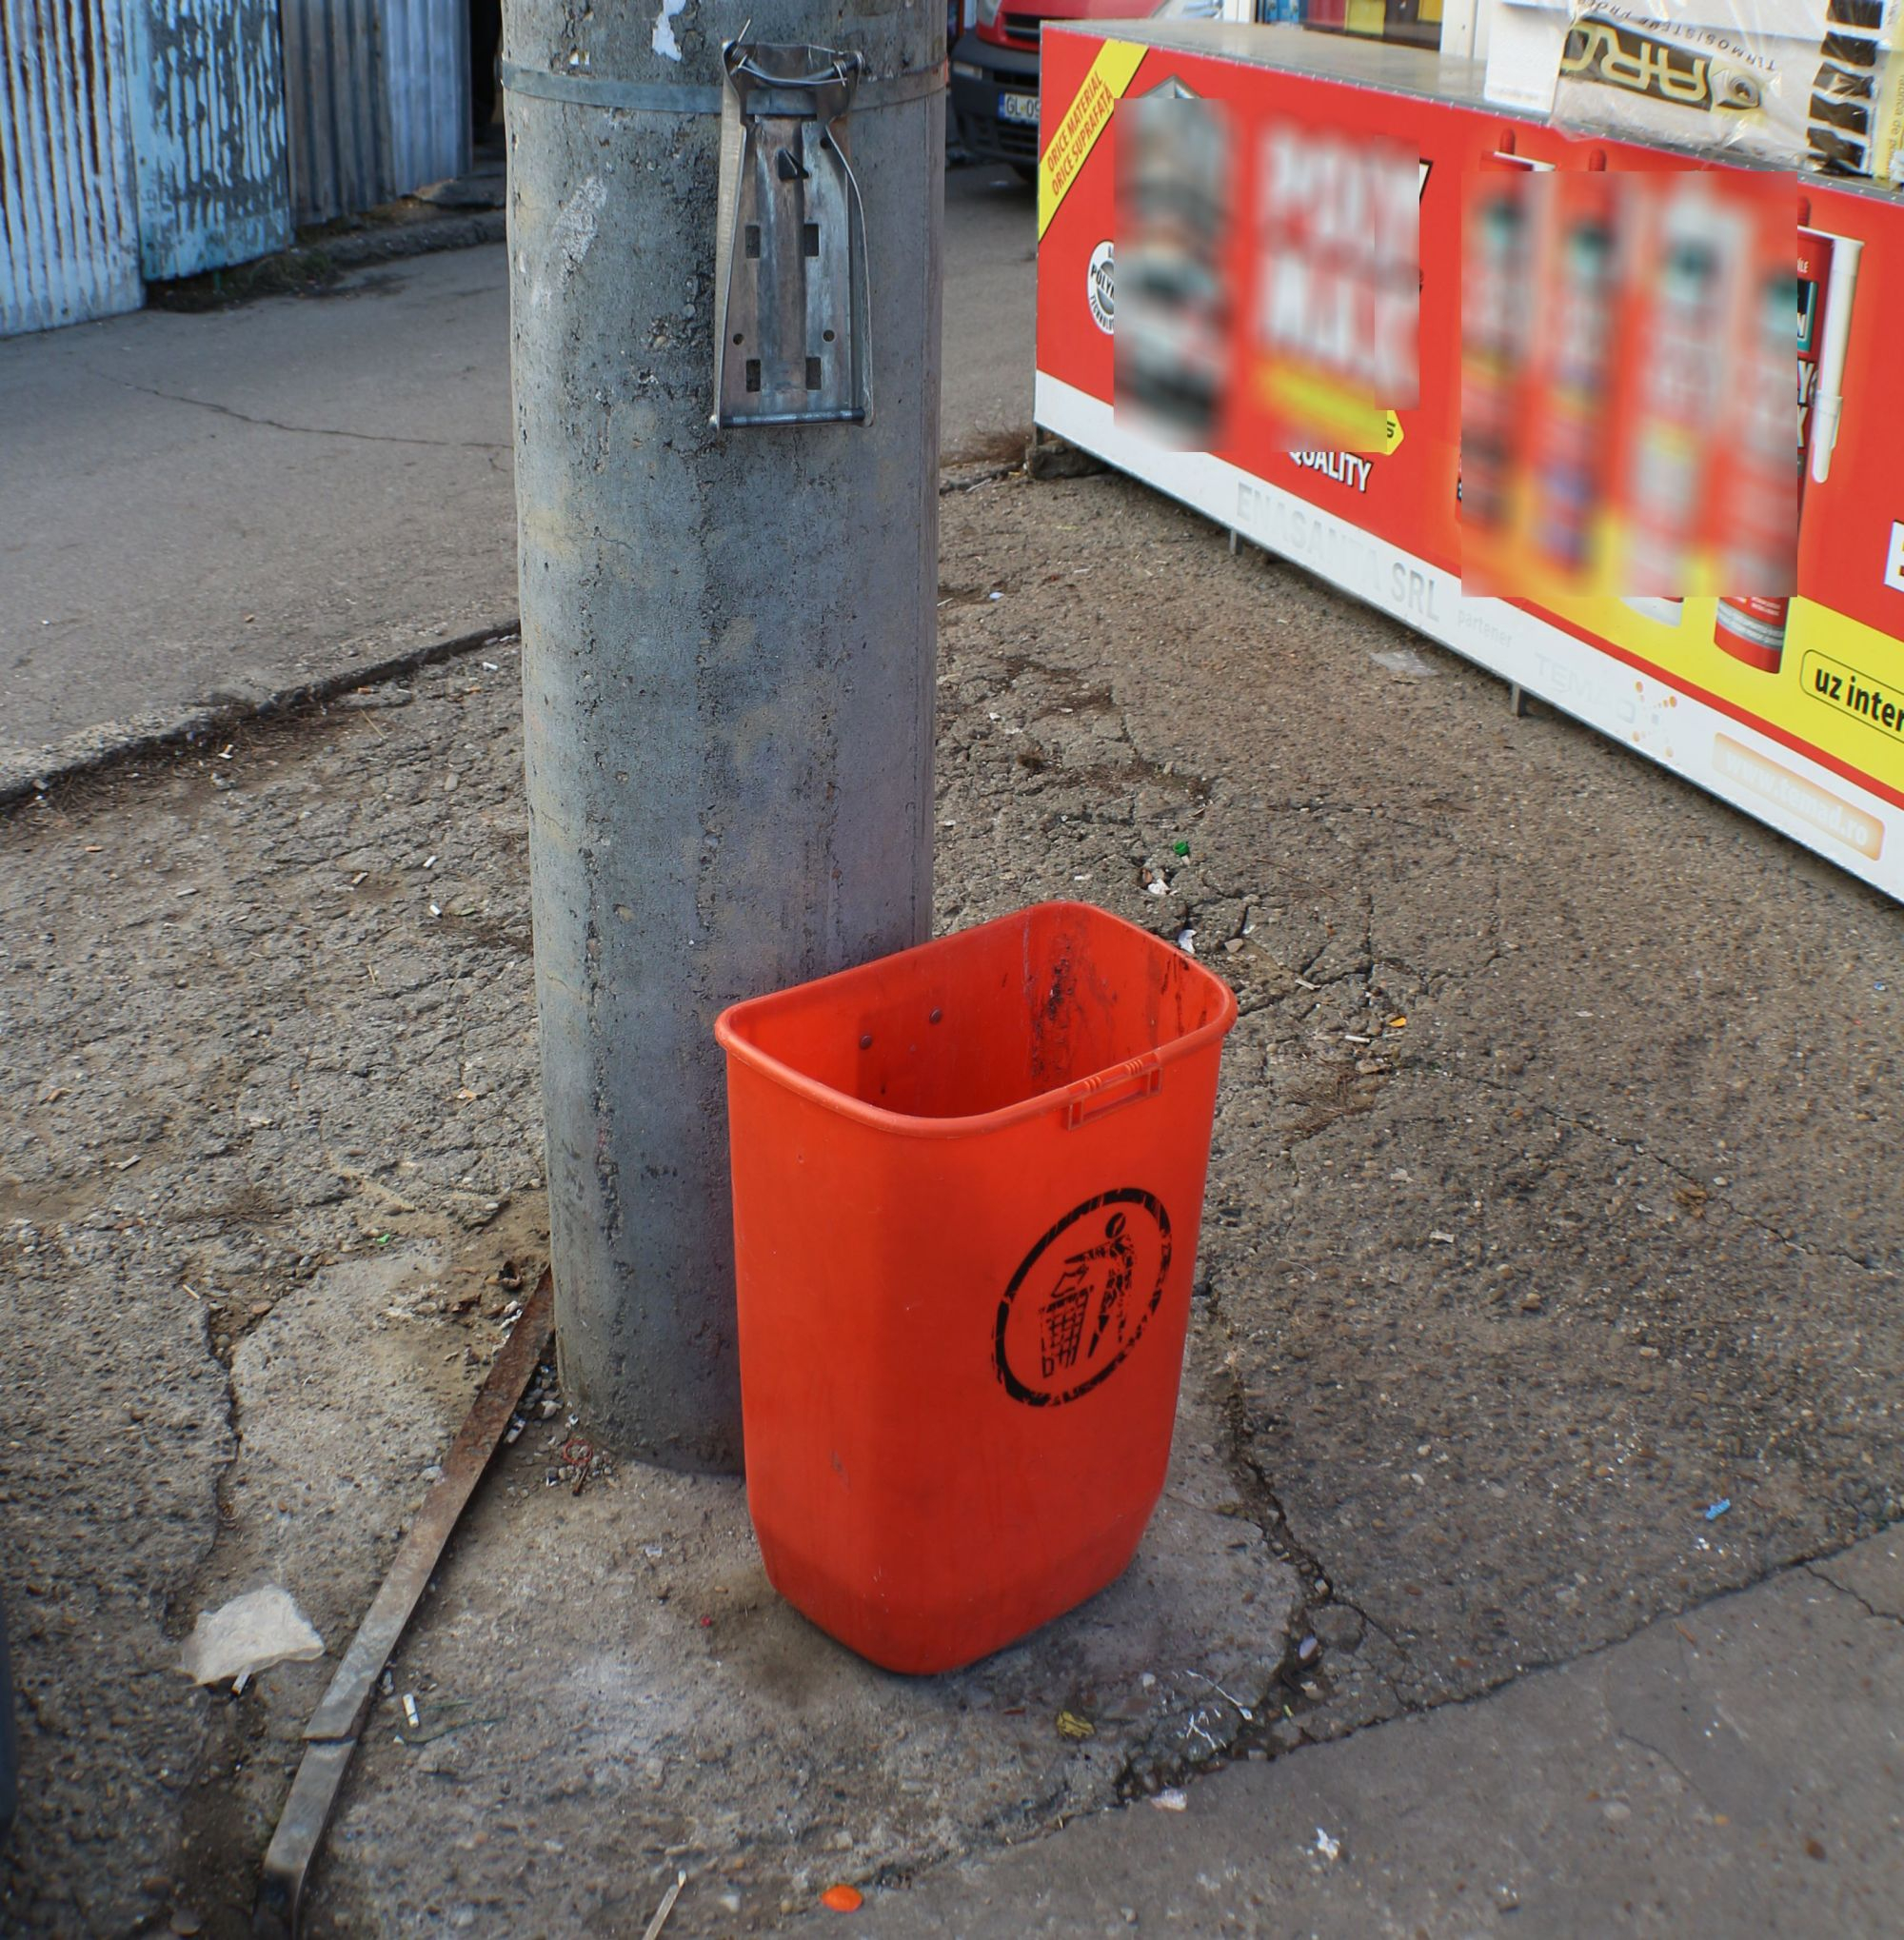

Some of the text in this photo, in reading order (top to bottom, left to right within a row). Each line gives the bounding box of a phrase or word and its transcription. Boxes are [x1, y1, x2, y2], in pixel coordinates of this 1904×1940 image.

[1047, 70, 1102, 173] ORICE MATERIAL
[1052, 153, 1074, 197] ORICE
[1390, 562, 1440, 623] SRL
[1458, 609, 1513, 648] partener
[1815, 668, 1843, 702] uz
